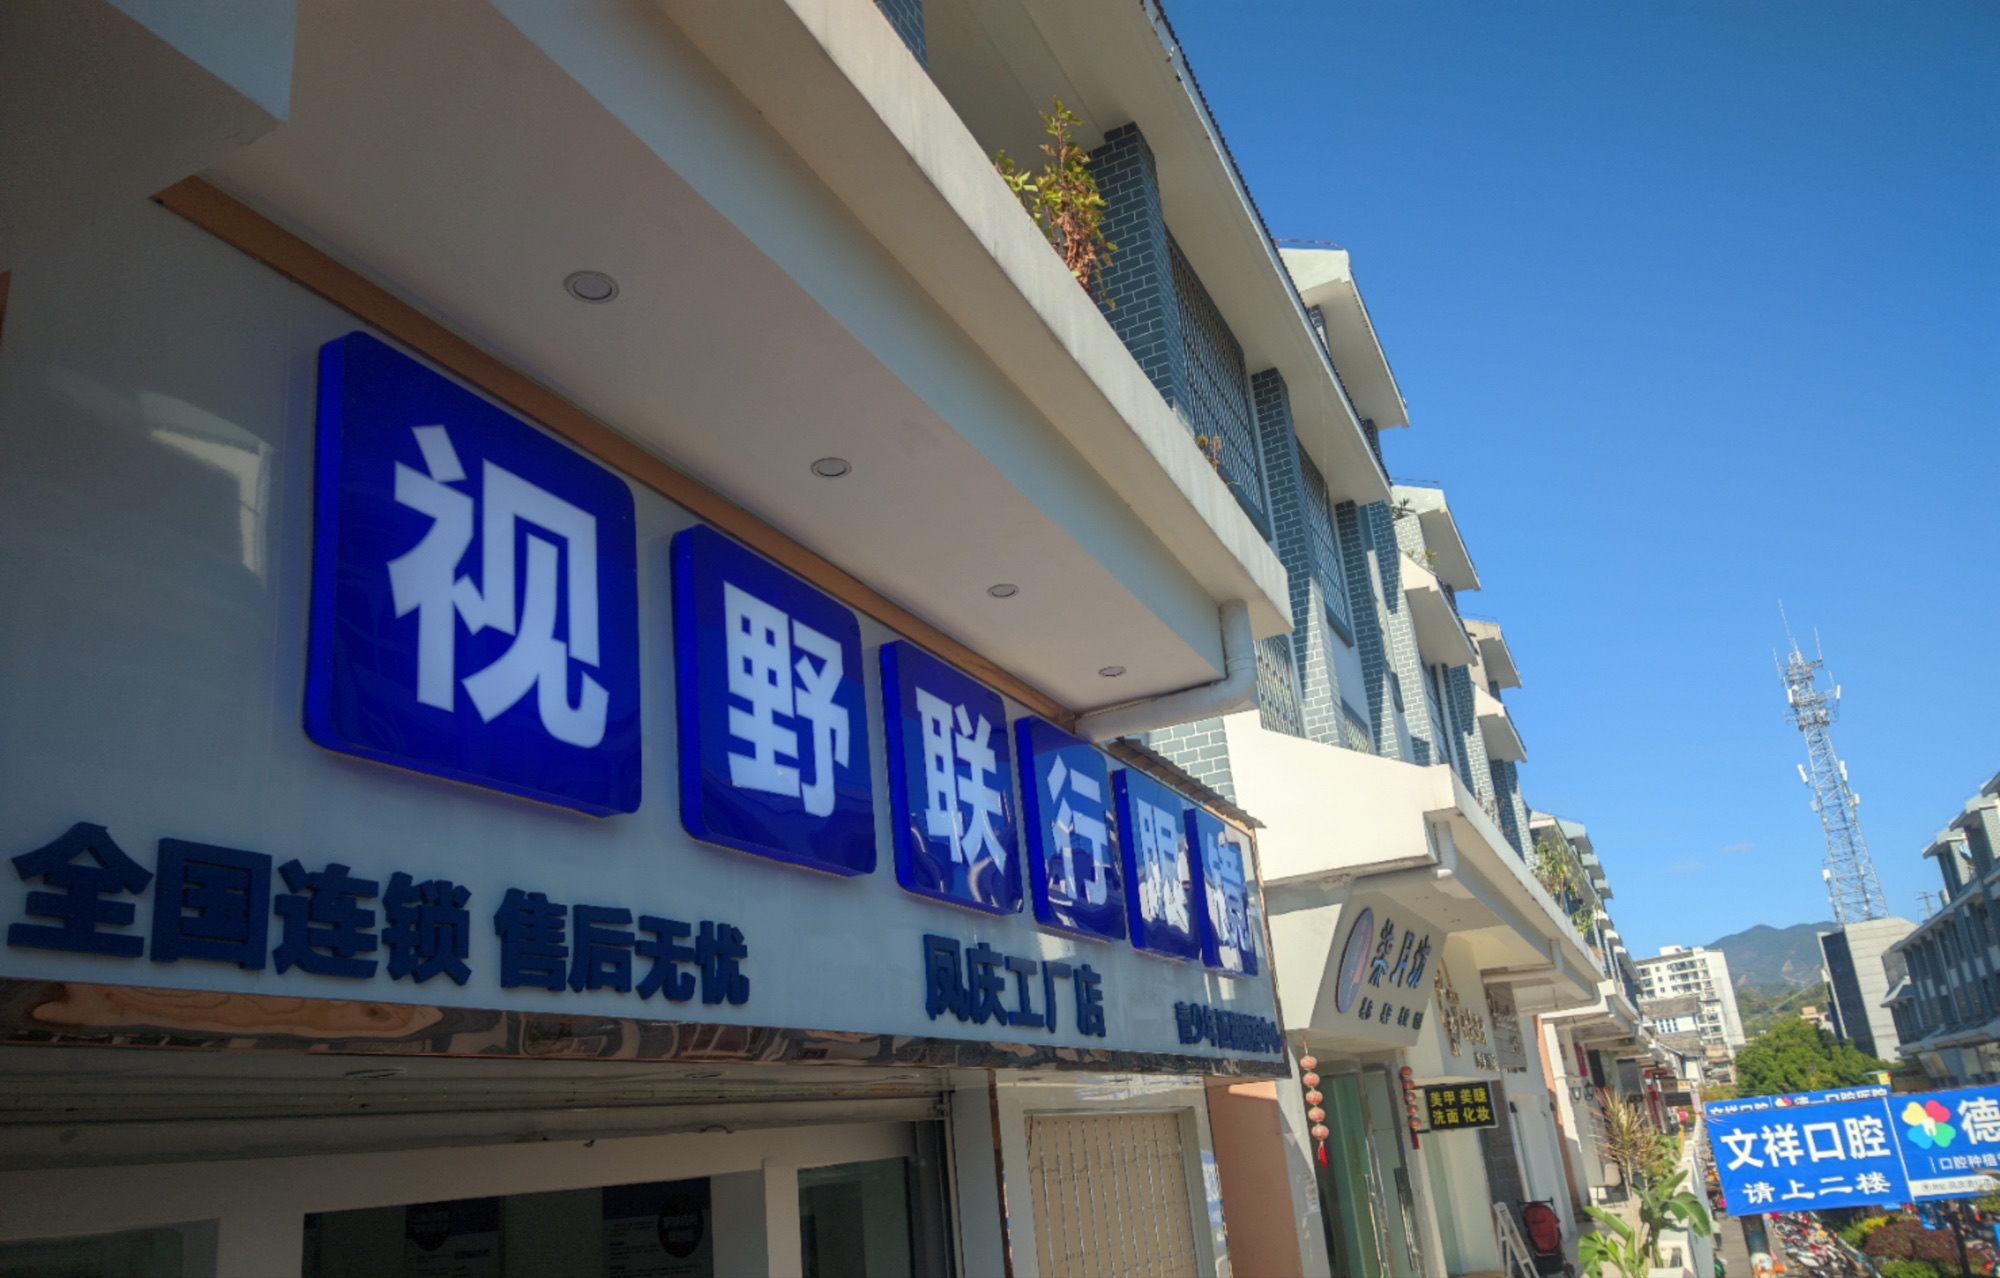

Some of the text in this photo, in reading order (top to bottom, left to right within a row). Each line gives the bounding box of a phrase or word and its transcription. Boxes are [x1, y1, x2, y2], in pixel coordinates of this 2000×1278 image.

[387, 424, 1252, 952] 视野联行眼镜
[7, 821, 750, 1005] 全国连锁 售后无忧
[923, 934, 1106, 1038] 凤庆工厂店
[1430, 1090, 1456, 1108] 美甲
[1432, 1106, 1491, 1126] 洗面 化妆
[1720, 1114, 1891, 1171] 文祥口腔
[1939, 1153, 2000, 1171] 口腔种植
[1742, 1171, 1891, 1205] 请上二楼
